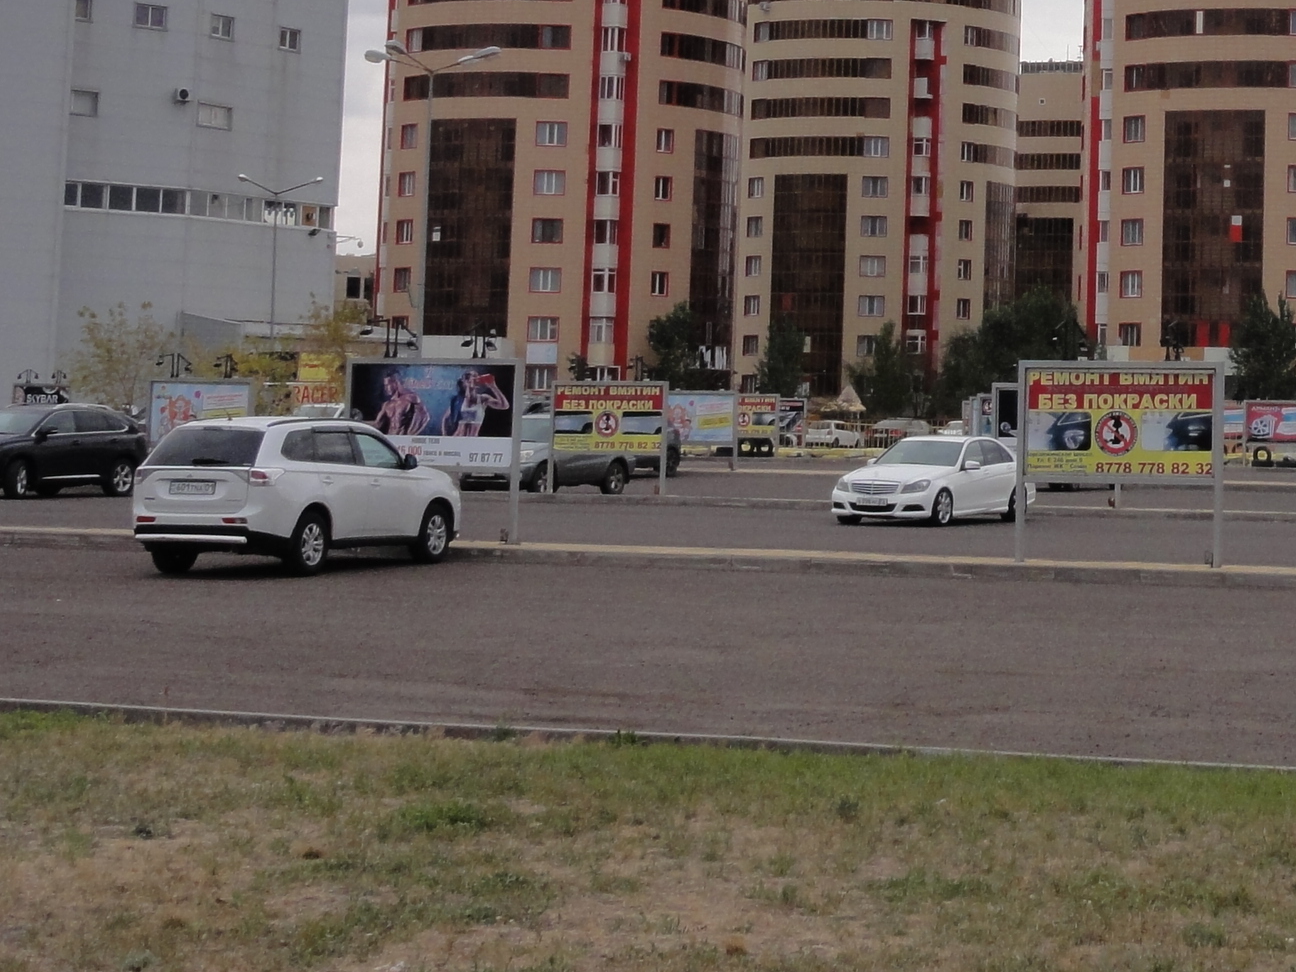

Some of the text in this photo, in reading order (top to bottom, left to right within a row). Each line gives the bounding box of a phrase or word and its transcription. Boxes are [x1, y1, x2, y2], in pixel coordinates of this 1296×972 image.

[1029, 372, 1209, 385] РЕМОНТ ВМЯТИН
[557, 386, 660, 395] РЕМОНТ ВМЯТИН
[562, 399, 653, 410] БЕЗ ПОКРАСКИ
[1038, 393, 1197, 409] БЕЗ ПОКРАСКИ
[594, 441, 615, 449] 8778
[619, 441, 634, 450] 778
[637, 441, 648, 450] 82
[1095, 462, 1132, 474] 8778
[1138, 462, 1165, 474] 778
[1171, 462, 1190, 474] 82
[1195, 462, 1213, 475] 32
